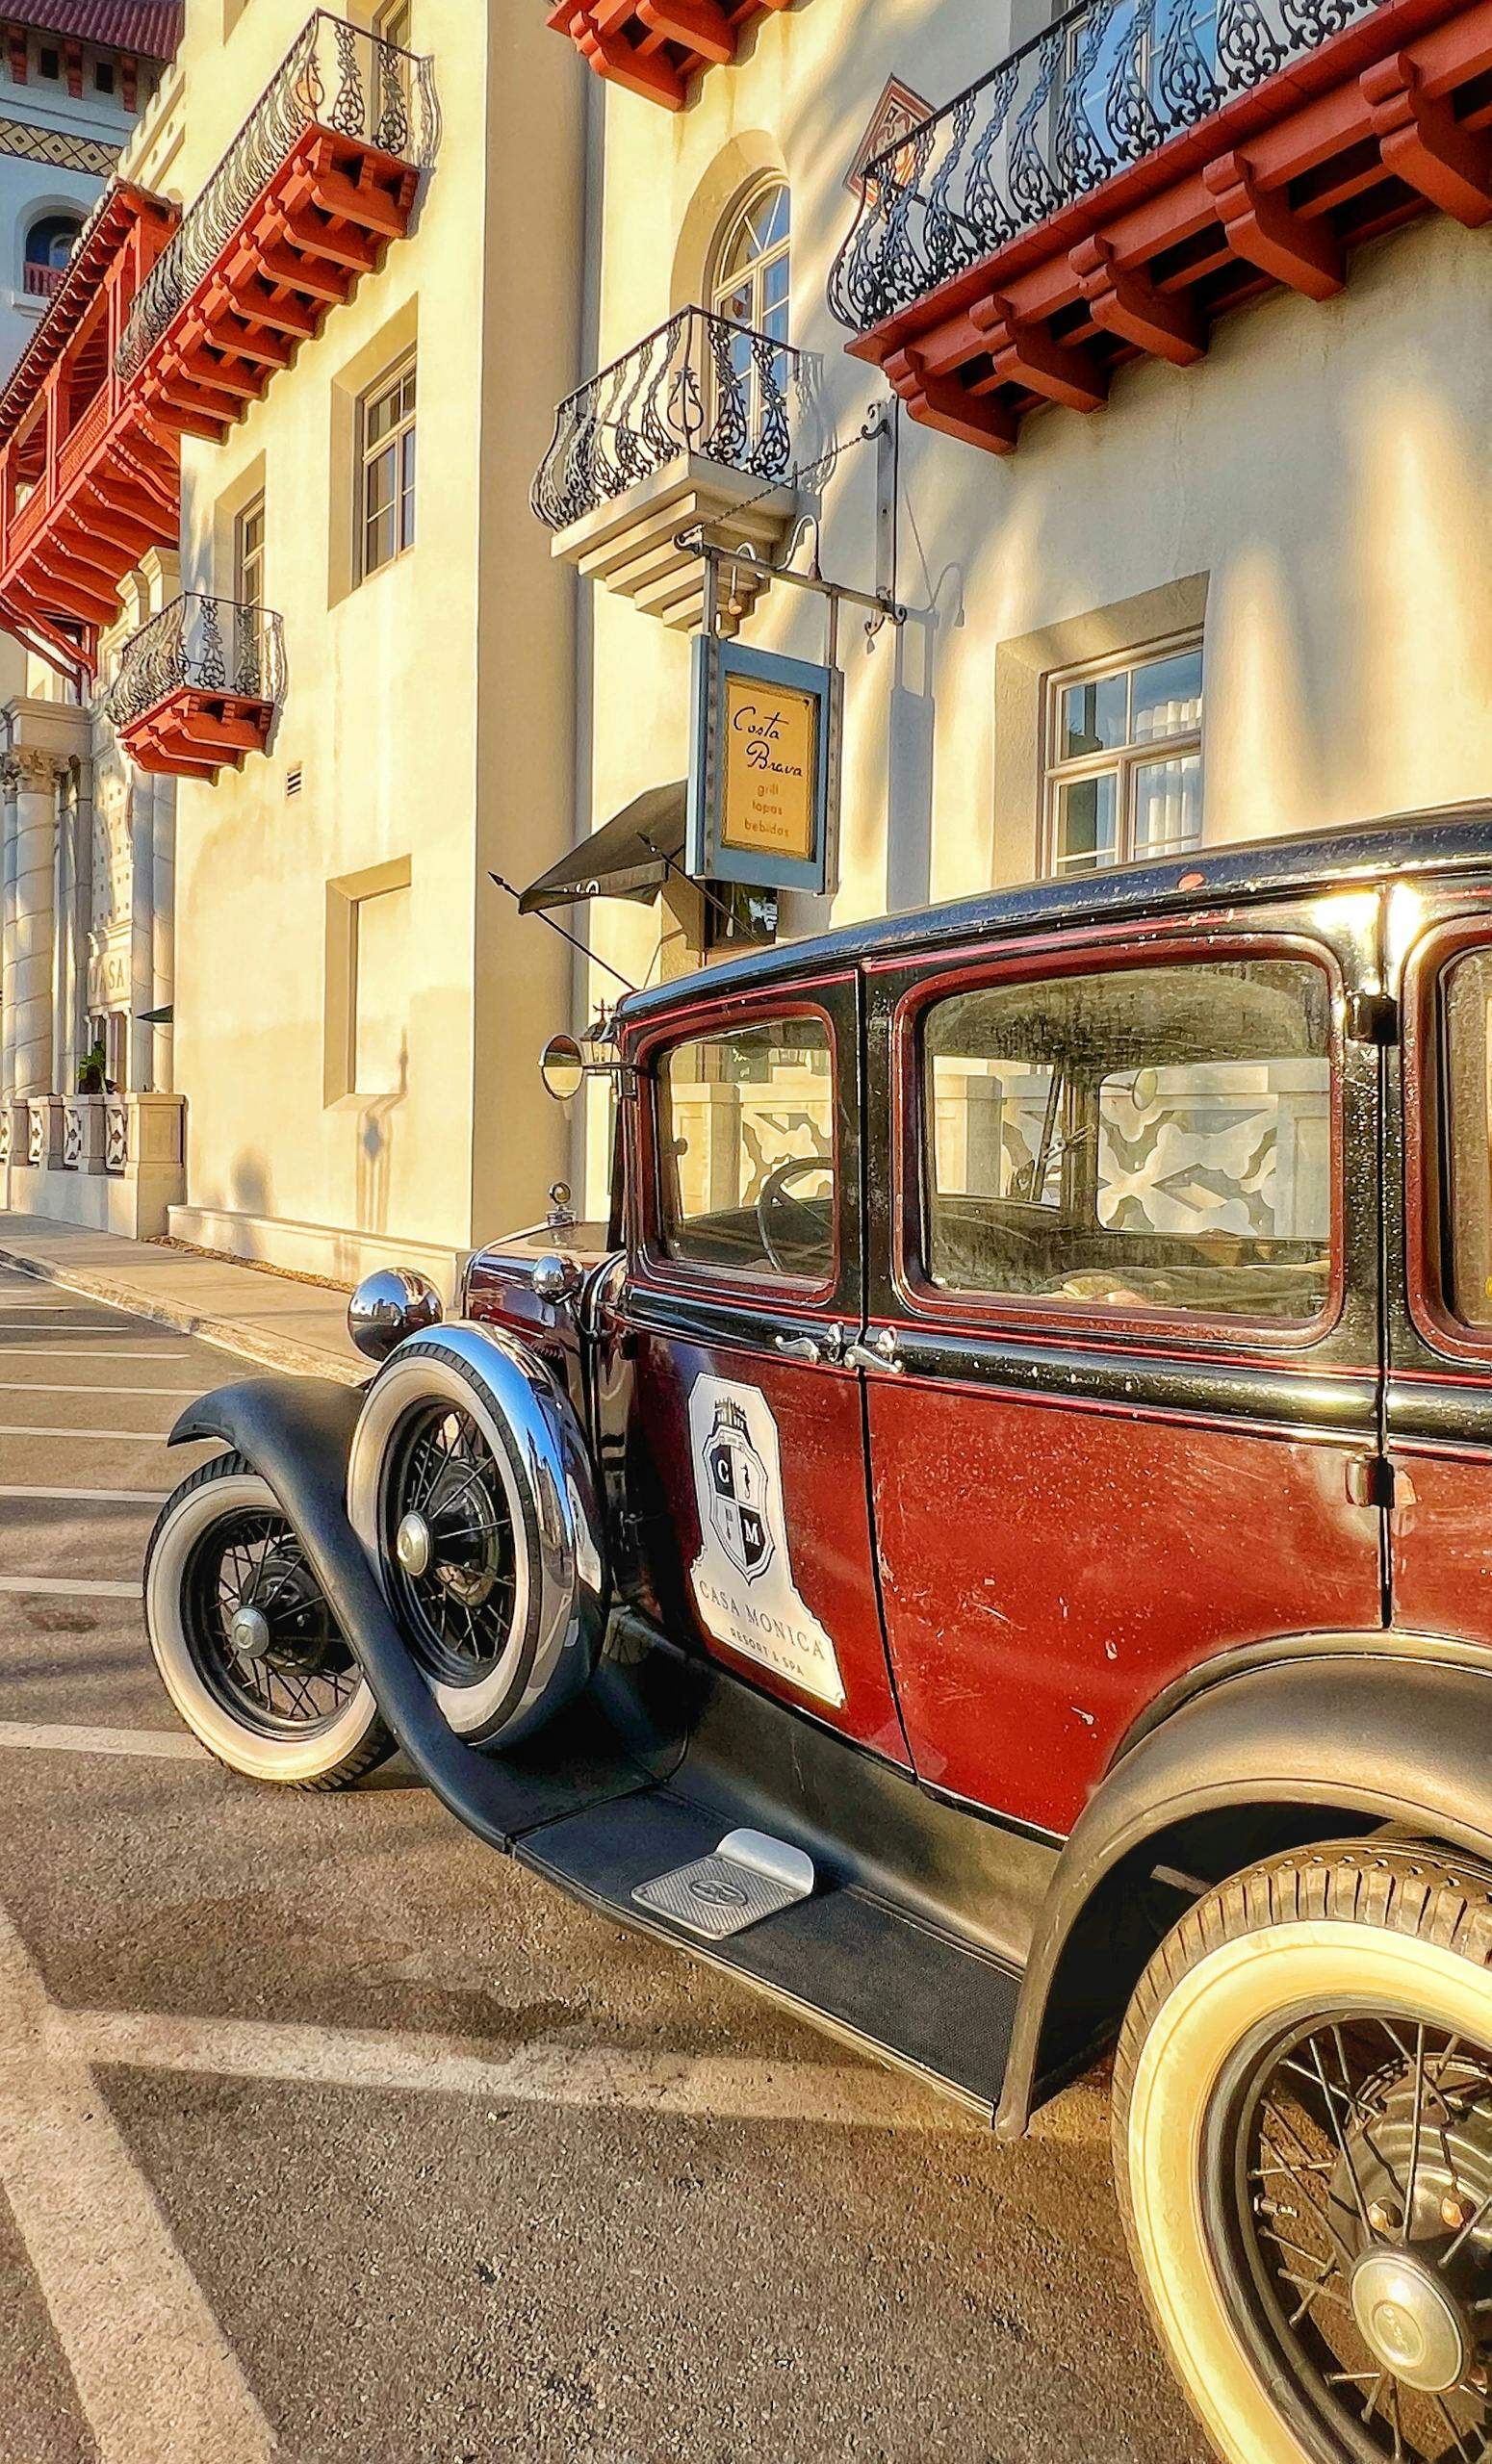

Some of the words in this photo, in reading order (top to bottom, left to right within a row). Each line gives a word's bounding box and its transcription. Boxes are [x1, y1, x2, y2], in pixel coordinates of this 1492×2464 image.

[733, 706, 789, 740] Costa
[746, 740, 804, 778] Brava
[757, 783, 779, 797] grill
[744, 818, 789, 837] bebidas
[743, 1519, 760, 1547] M
[699, 1579, 740, 1617] CASA
[745, 1604, 826, 1660] MONICA
[730, 1627, 769, 1656] RESORT
